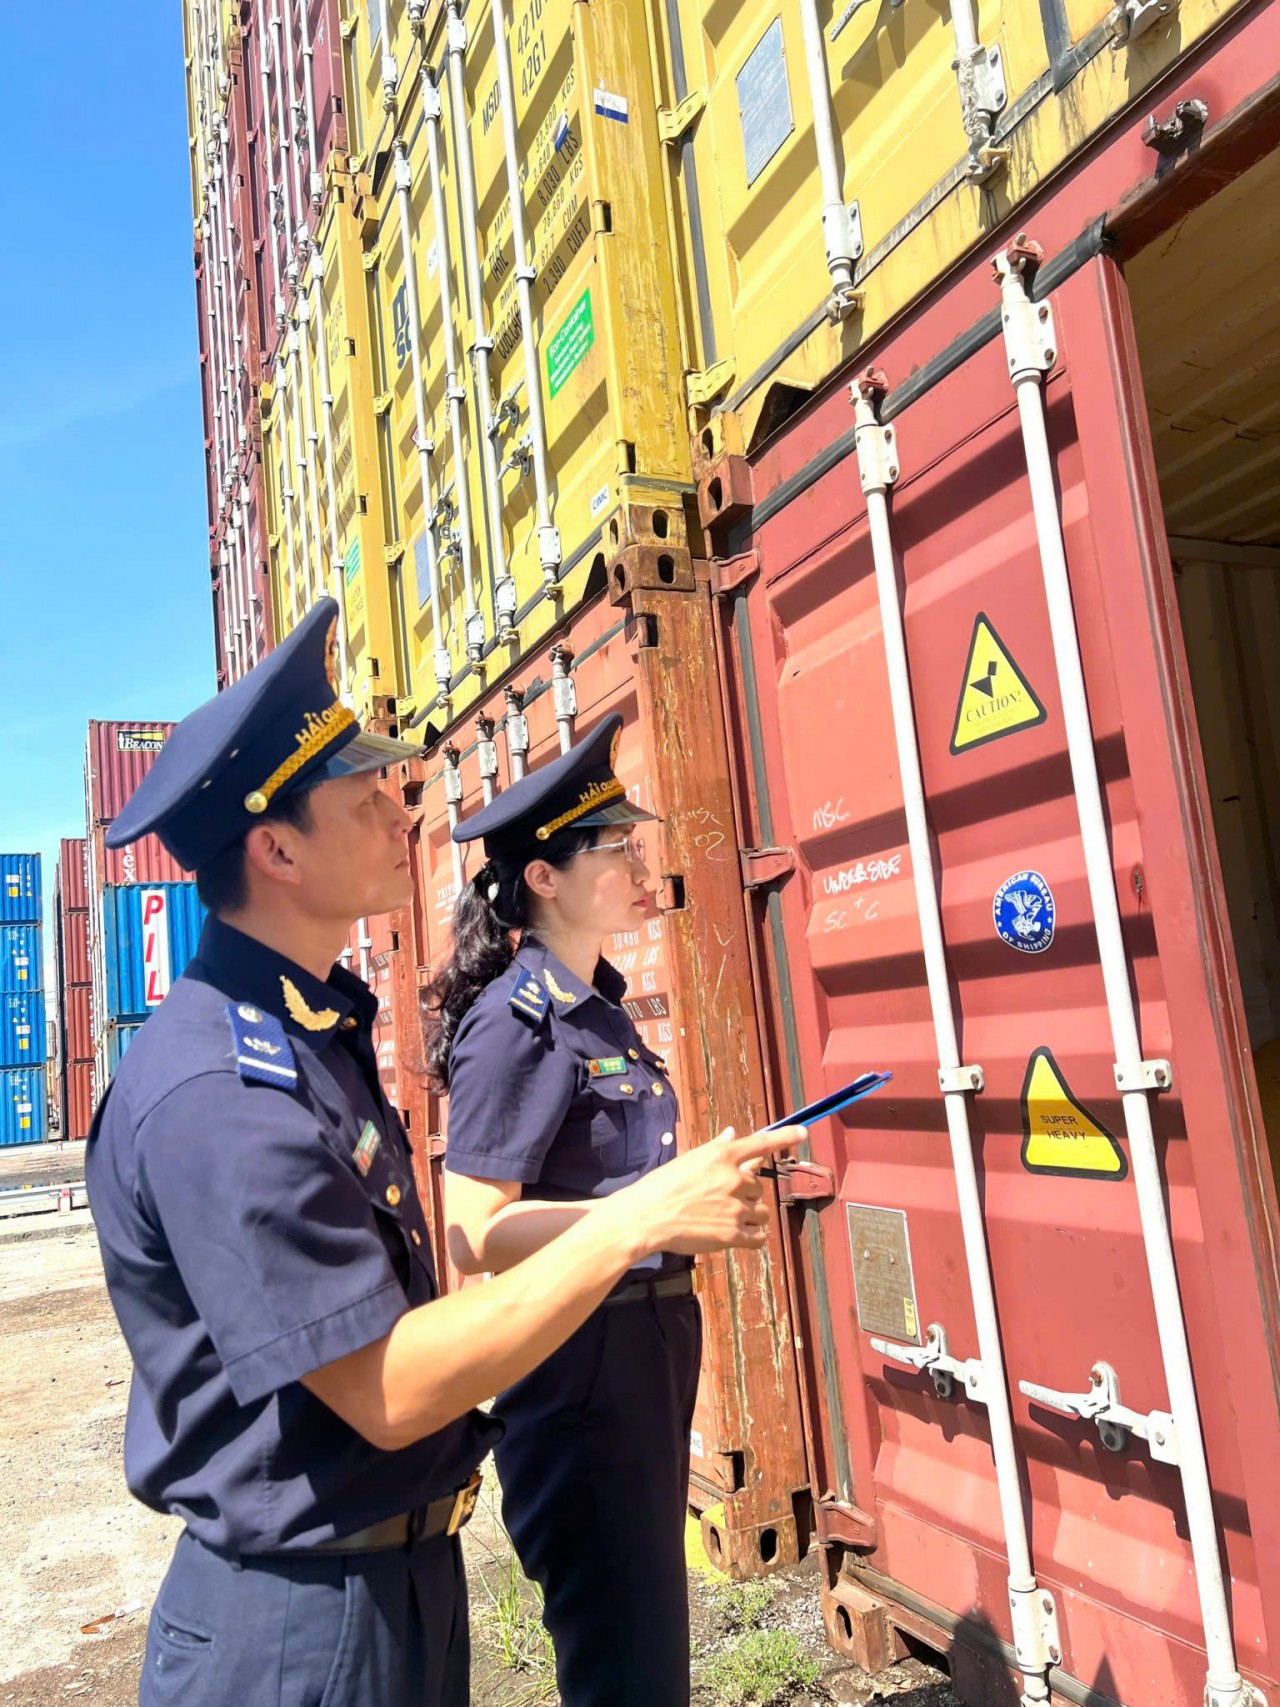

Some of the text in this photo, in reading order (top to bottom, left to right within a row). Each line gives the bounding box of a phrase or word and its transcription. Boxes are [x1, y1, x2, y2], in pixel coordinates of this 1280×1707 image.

[522, 29, 546, 97] 42G1
[561, 68, 574, 102] KGS
[569, 153, 583, 187] KGS
[567, 217, 588, 255] CUFT
[994, 873, 1053, 916] AMERICAN BUREAU
[647, 919, 662, 941] KGS
[1002, 928, 1052, 950] OF SHIPPING
[144, 895, 164, 1001] PIL
[647, 997, 667, 1016] LBS
[657, 1022, 673, 1043] KGS
[1040, 1115, 1079, 1125] SUPER
[1046, 1130, 1086, 1141] HEAVY
